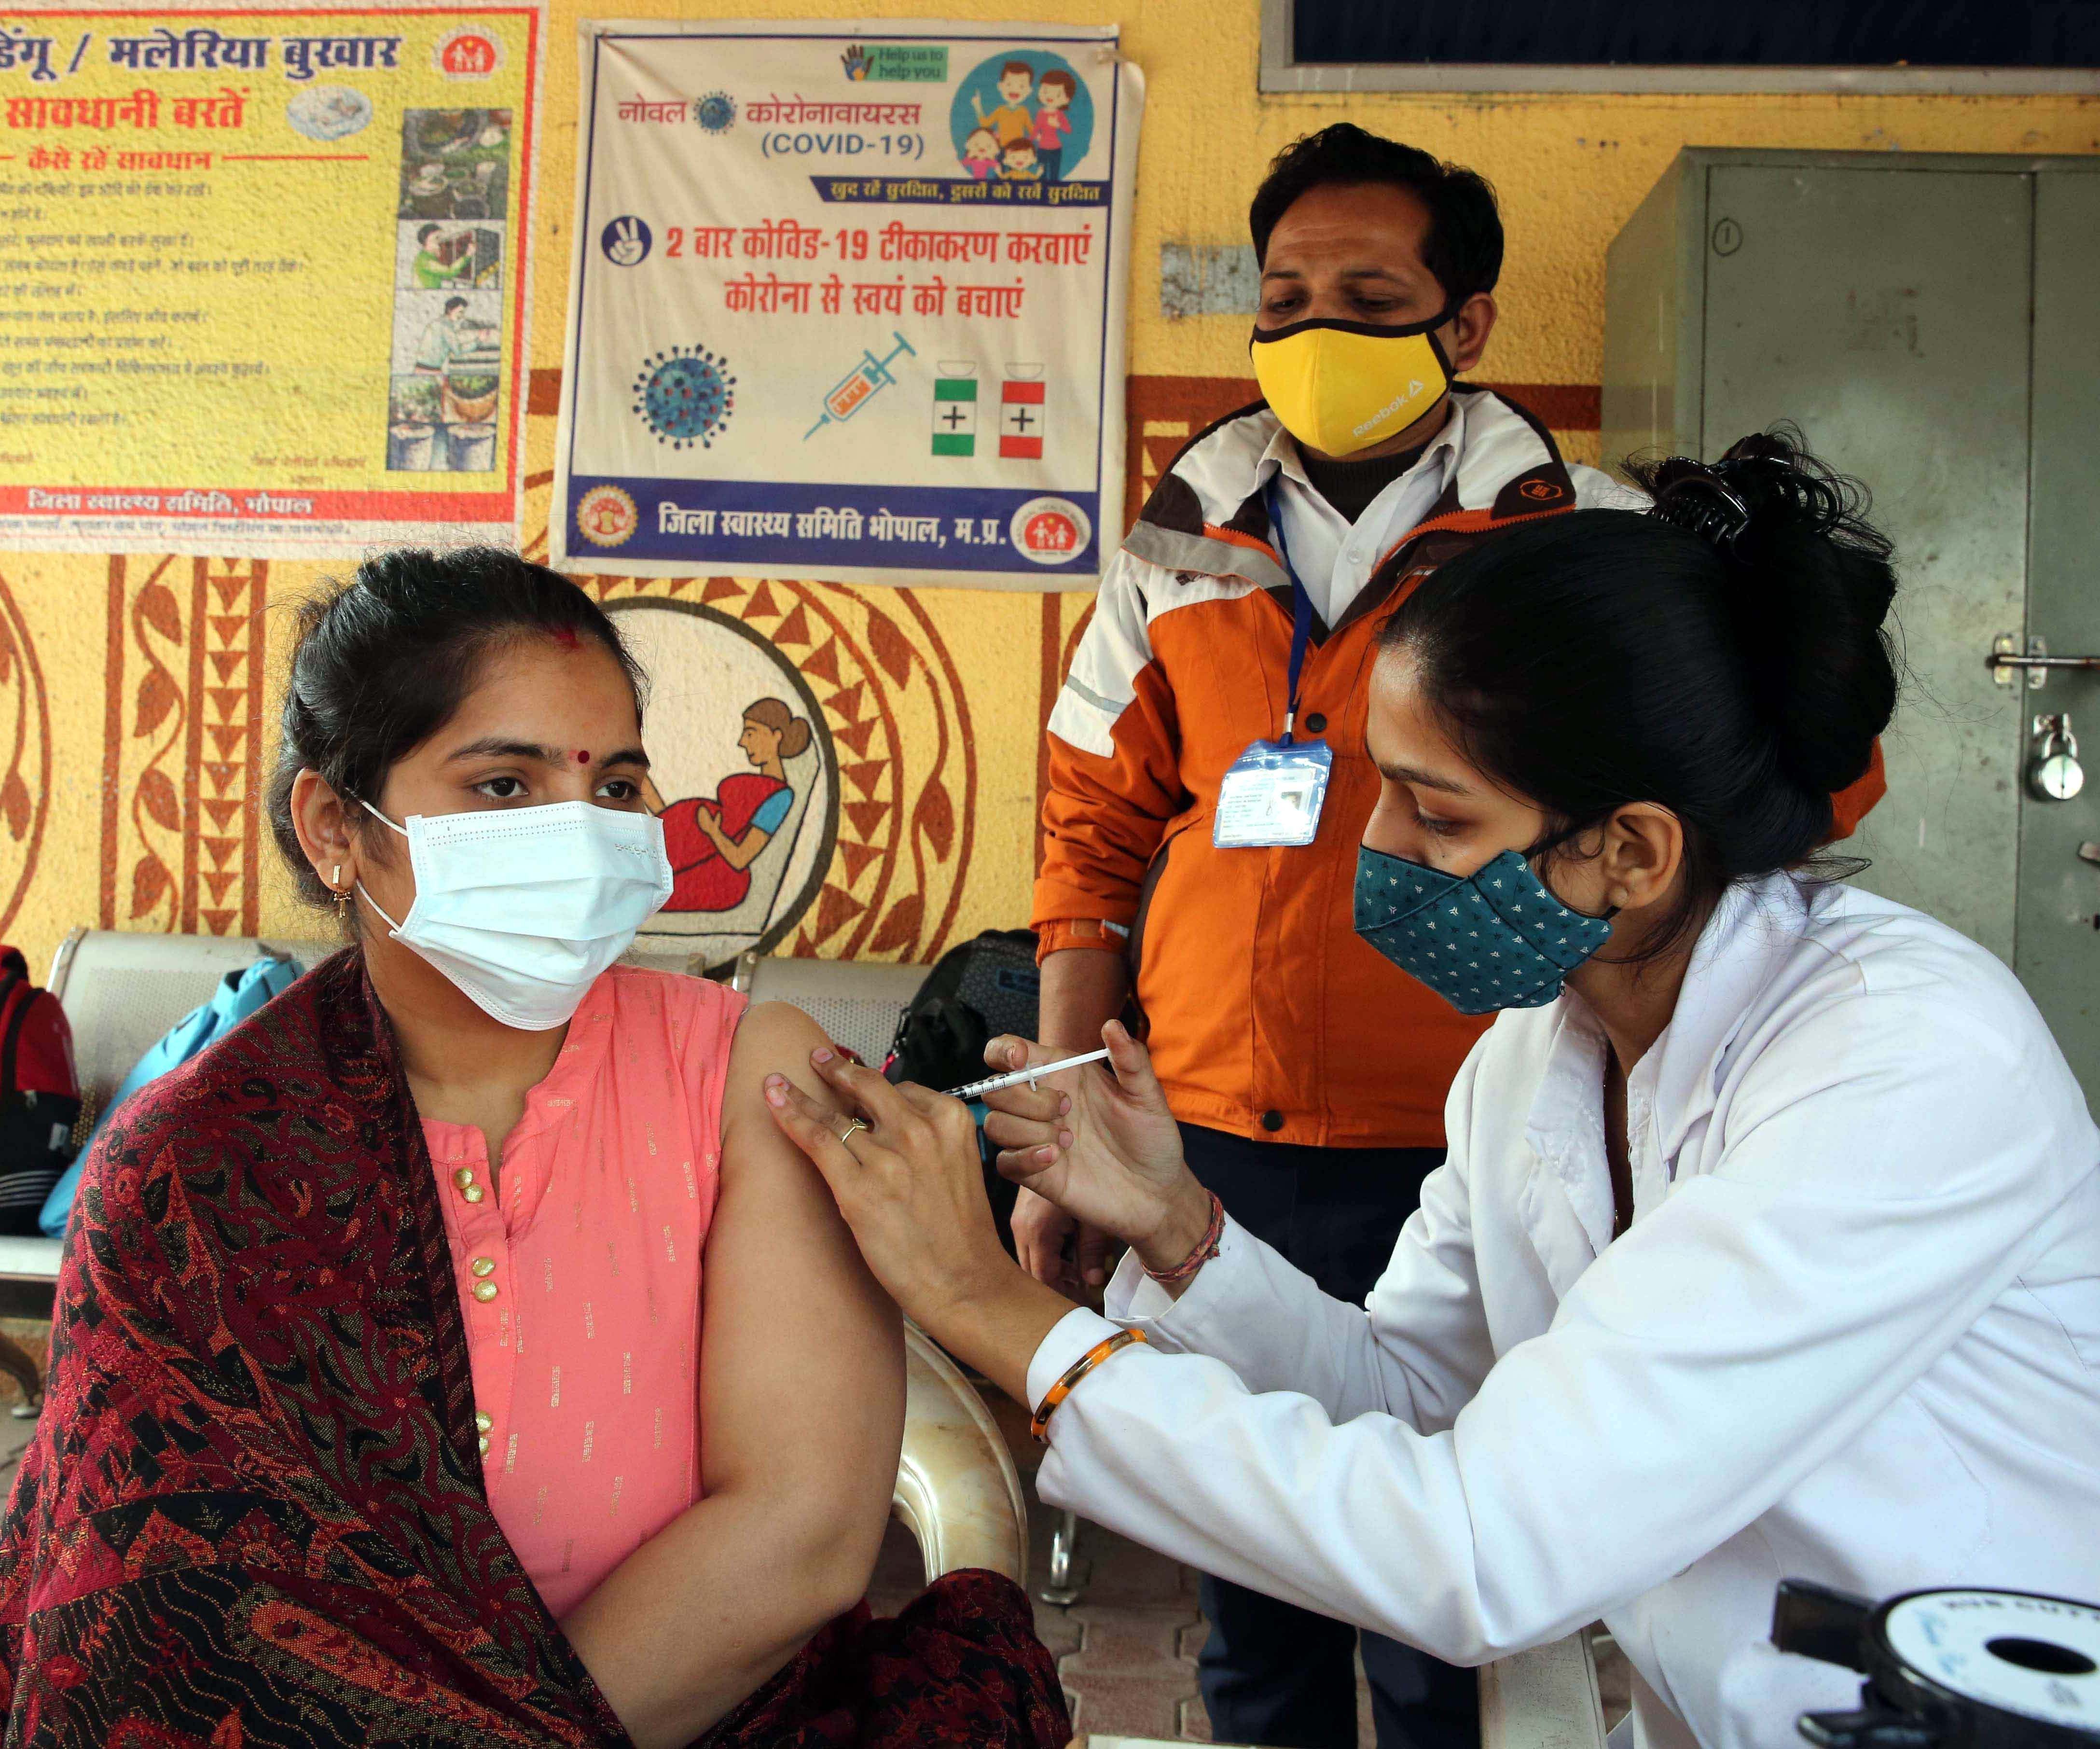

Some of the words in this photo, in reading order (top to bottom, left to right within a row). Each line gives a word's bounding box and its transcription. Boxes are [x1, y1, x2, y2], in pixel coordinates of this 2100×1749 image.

[108, 28, 271, 68] मलेरिया
[282, 37, 402, 80] बुखार
[880, 47, 910, 62] Help
[912, 50, 927, 60] us
[930, 49, 943, 60] to
[880, 65, 910, 81] help
[914, 67, 941, 79] you
[6, 88, 161, 129] सावधानी
[172, 87, 250, 129] बरतें
[618, 93, 687, 124] नोवल
[746, 93, 923, 125] कोरोनावायरस
[28, 144, 71, 170] कैसे
[80, 144, 112, 170] रहें
[117, 151, 213, 170] सावधान
[761, 133, 925, 160] (COVID-19)
[992, 182, 1012, 199] को
[666, 227, 683, 259] 2
[694, 226, 737, 259] बार
[742, 218, 869, 261] कोविड-19
[879, 220, 999, 263] टीकाकरण
[1007, 223, 1094, 265] करवाएं
[724, 272, 812, 314] कोरोना
[819, 274, 844, 315] से
[852, 275, 905, 315] स्वयं
[913, 276, 945, 317] को
[956, 278, 1025, 319] बचाएं
[28, 487, 82, 510] जिला
[86, 494, 160, 512] स्वास्थ्य
[165, 489, 239, 516] समिति,
[658, 502, 715, 536] जिला
[720, 508, 791, 539] स्वास्थ्य
[796, 506, 864, 540] समिति
[869, 510, 947, 549] भोपाल,
[954, 517, 1007, 546] म.प्र.
